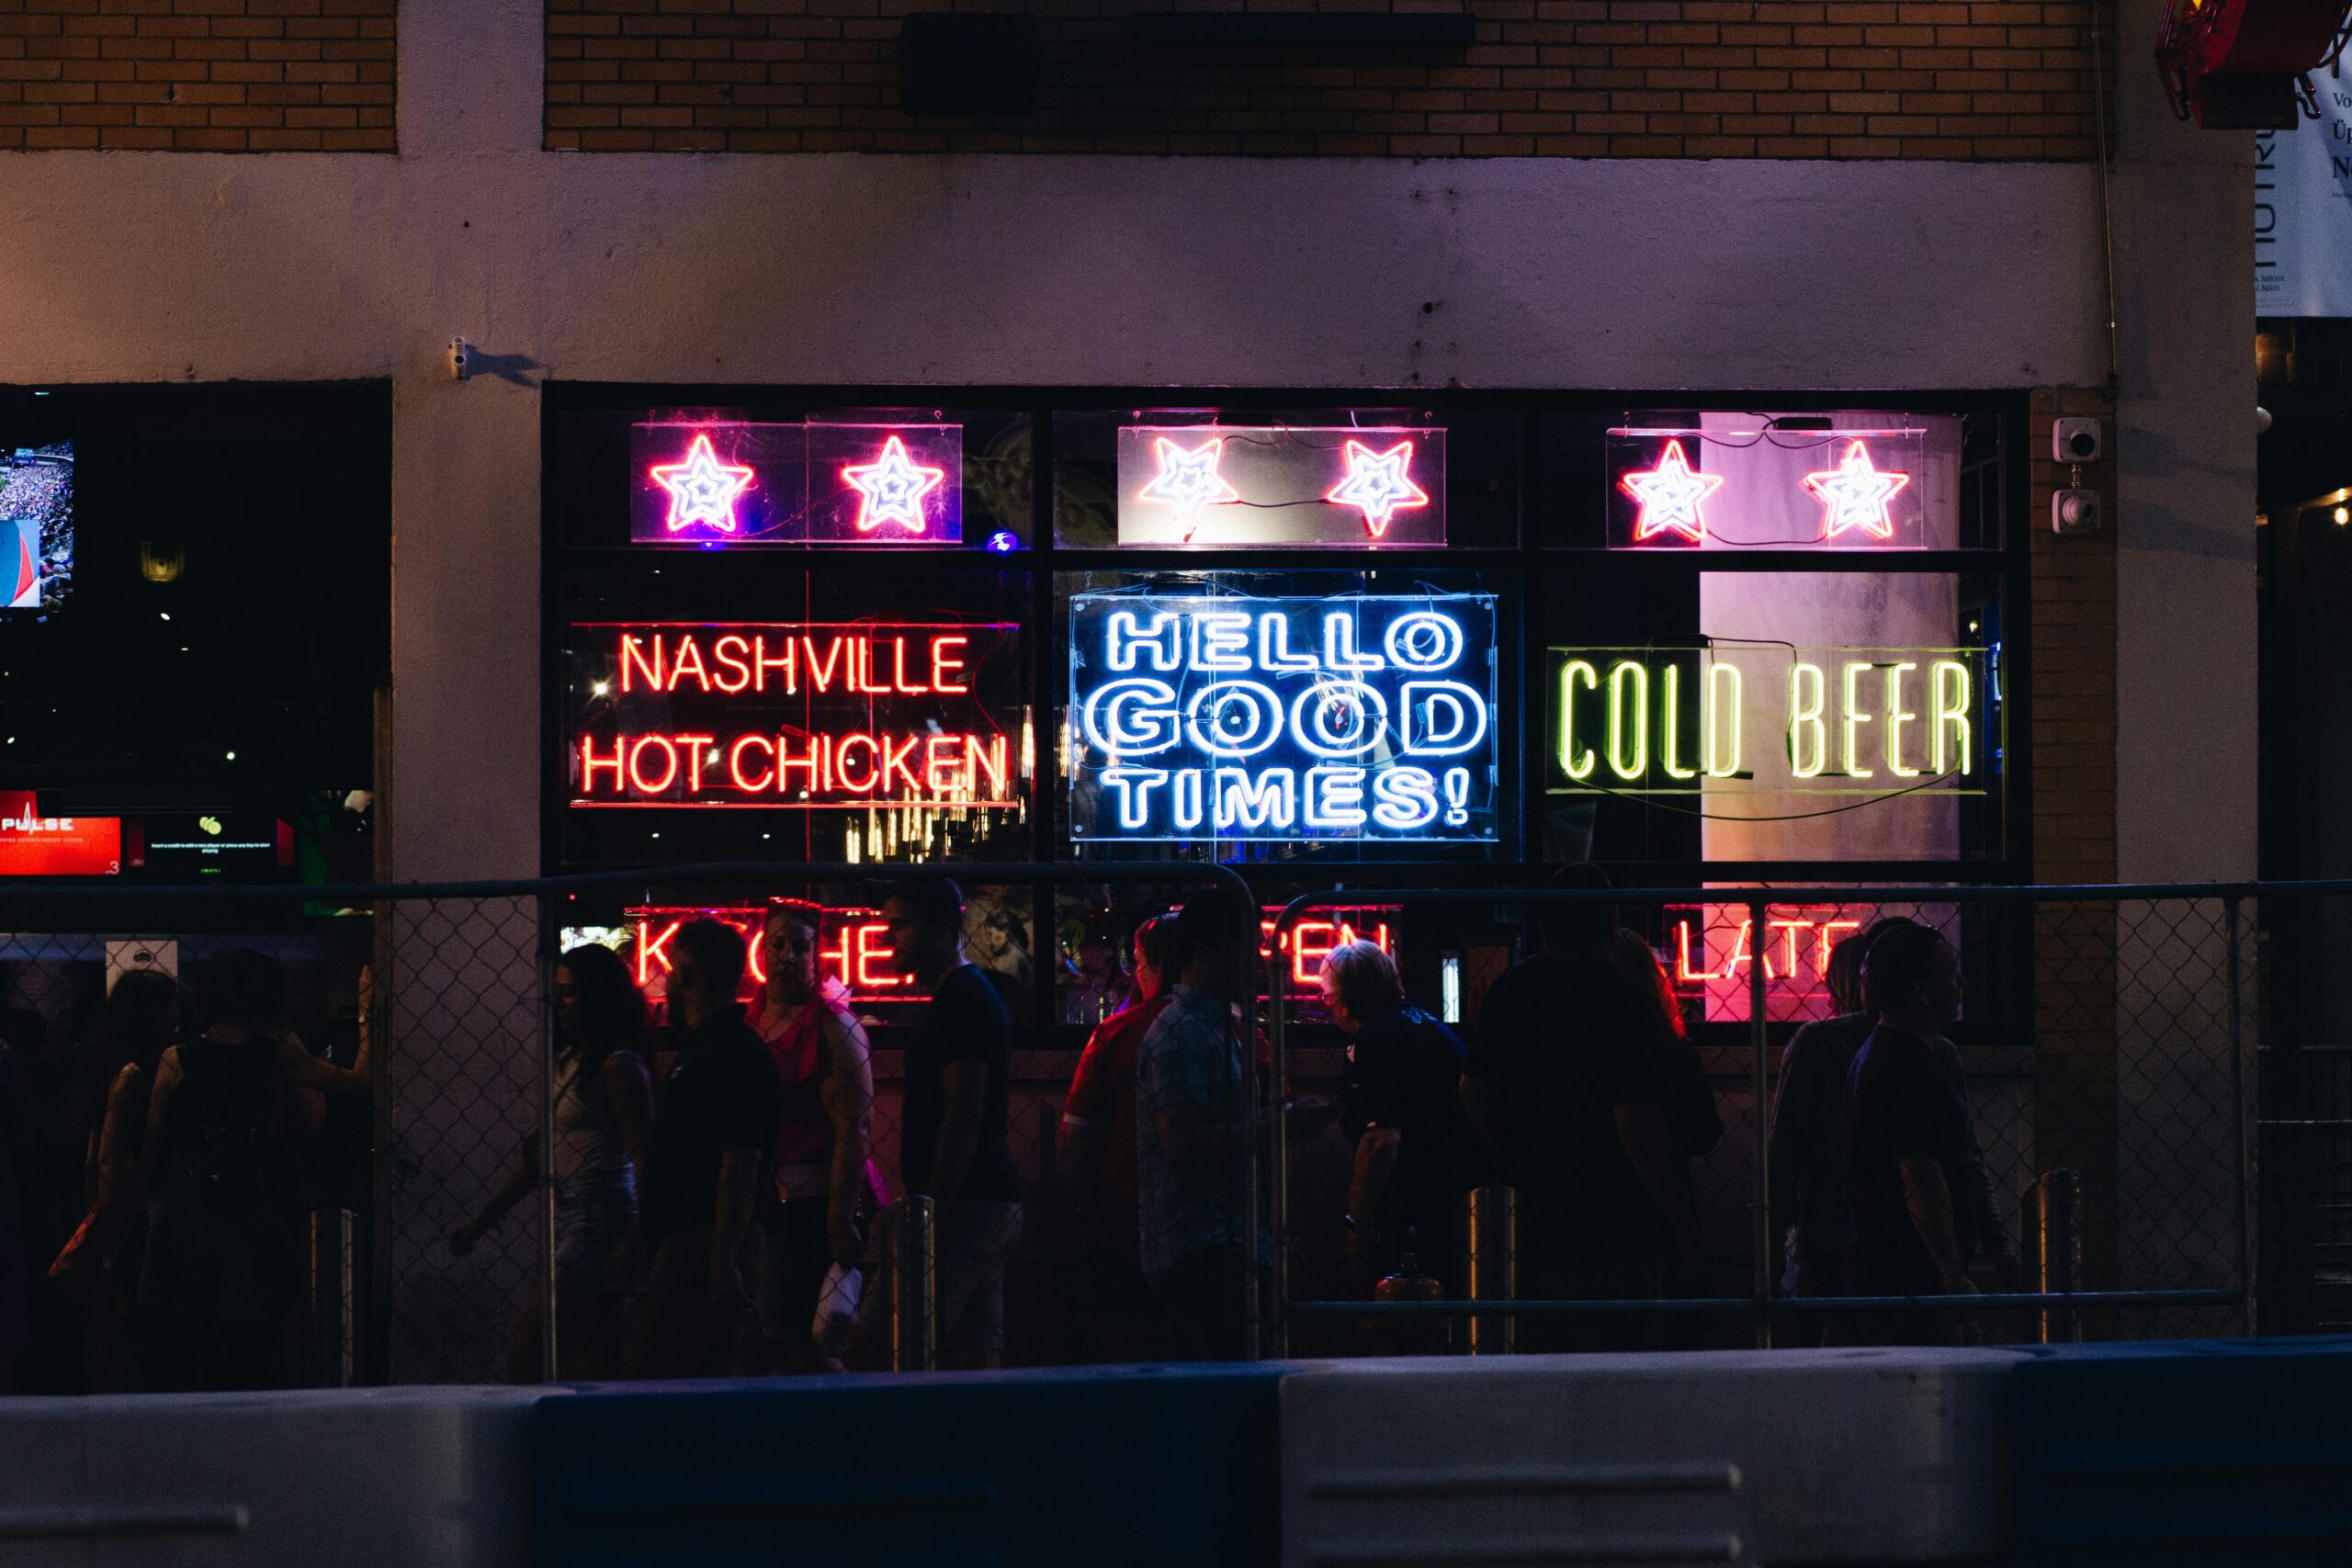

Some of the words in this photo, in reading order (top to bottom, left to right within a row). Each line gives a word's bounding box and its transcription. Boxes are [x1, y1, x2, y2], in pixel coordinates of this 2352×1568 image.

[2333, 93, 2352, 107] Vo
[621, 634, 968, 694] NASHVILLE
[1108, 612, 1464, 671] HELLO
[1083, 678, 1487, 758] GOOD
[1561, 660, 1743, 778] COLD
[1790, 661, 1971, 778] BEER
[582, 735, 714, 793] HOT
[730, 734, 1007, 793] CHICKEN
[1099, 766, 1471, 828] TIMES!
